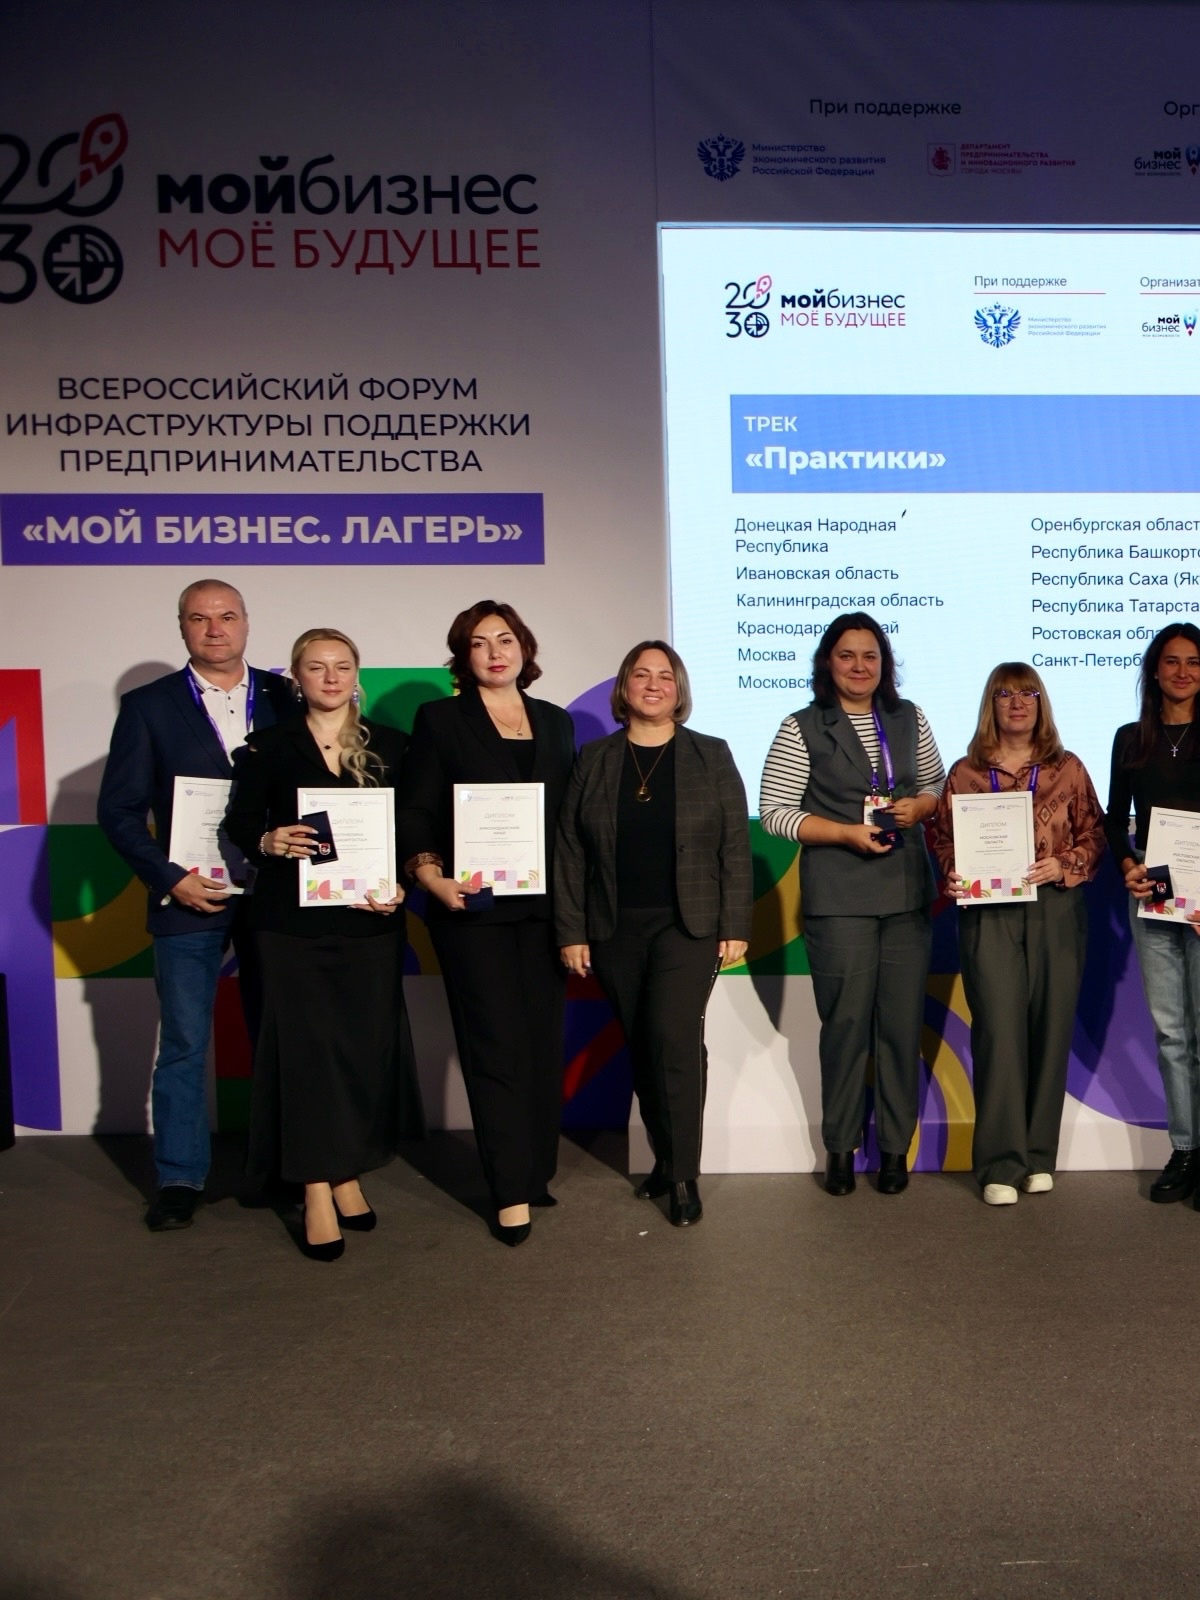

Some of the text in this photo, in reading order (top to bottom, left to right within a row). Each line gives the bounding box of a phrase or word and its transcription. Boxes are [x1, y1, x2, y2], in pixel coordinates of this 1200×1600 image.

[810, 99, 961, 118] При поддержке
[752, 144, 826, 153] Министерство
[1153, 147, 1181, 159] мой
[753, 155, 886, 166] экономического развития
[1134, 156, 1181, 170] бизнес
[753, 166, 875, 176] Российской Федерации
[159, 221, 540, 275] МОЁ БУДУЩЕЕ
[974, 276, 1067, 288] При поддержке
[781, 310, 905, 328] МОЁ БУДУЩЕЕ
[1142, 322, 1180, 332] бизнес
[1158, 315, 1180, 324] мой
[58, 373, 477, 400] ВСЕРОССИЙСКИЙ ФОРУМ
[7, 413, 529, 440] ИНФРАСТРУКТУРЫ ПОДДЕРЖКИ
[744, 415, 797, 431] ТРЕК
[60, 450, 482, 476] ПРЕДПРИНИМАТЕЛЬСТВА
[745, 446, 946, 475] «Практики»
[23, 509, 522, 544] «МОЙ БИЗНЕС. ЛАГЕРЬ»
[735, 518, 896, 534] Донецкая Народная
[1031, 518, 1140, 534] Оренбургская
[736, 539, 828, 555] Республика
[1032, 545, 1123, 561] Республика
[737, 566, 899, 579] Ивановская область
[1032, 572, 1123, 588] Республика
[1129, 572, 1168, 585] Саха
[737, 593, 944, 609] Калининградская область
[1032, 599, 1123, 615] Республика
[738, 621, 829, 637] Краснодарс
[1033, 627, 1120, 640] Ростовская
[738, 648, 795, 661] Москва
[1032, 653, 1142, 669] Санкт-Петерб
[739, 676, 813, 689] Московск
